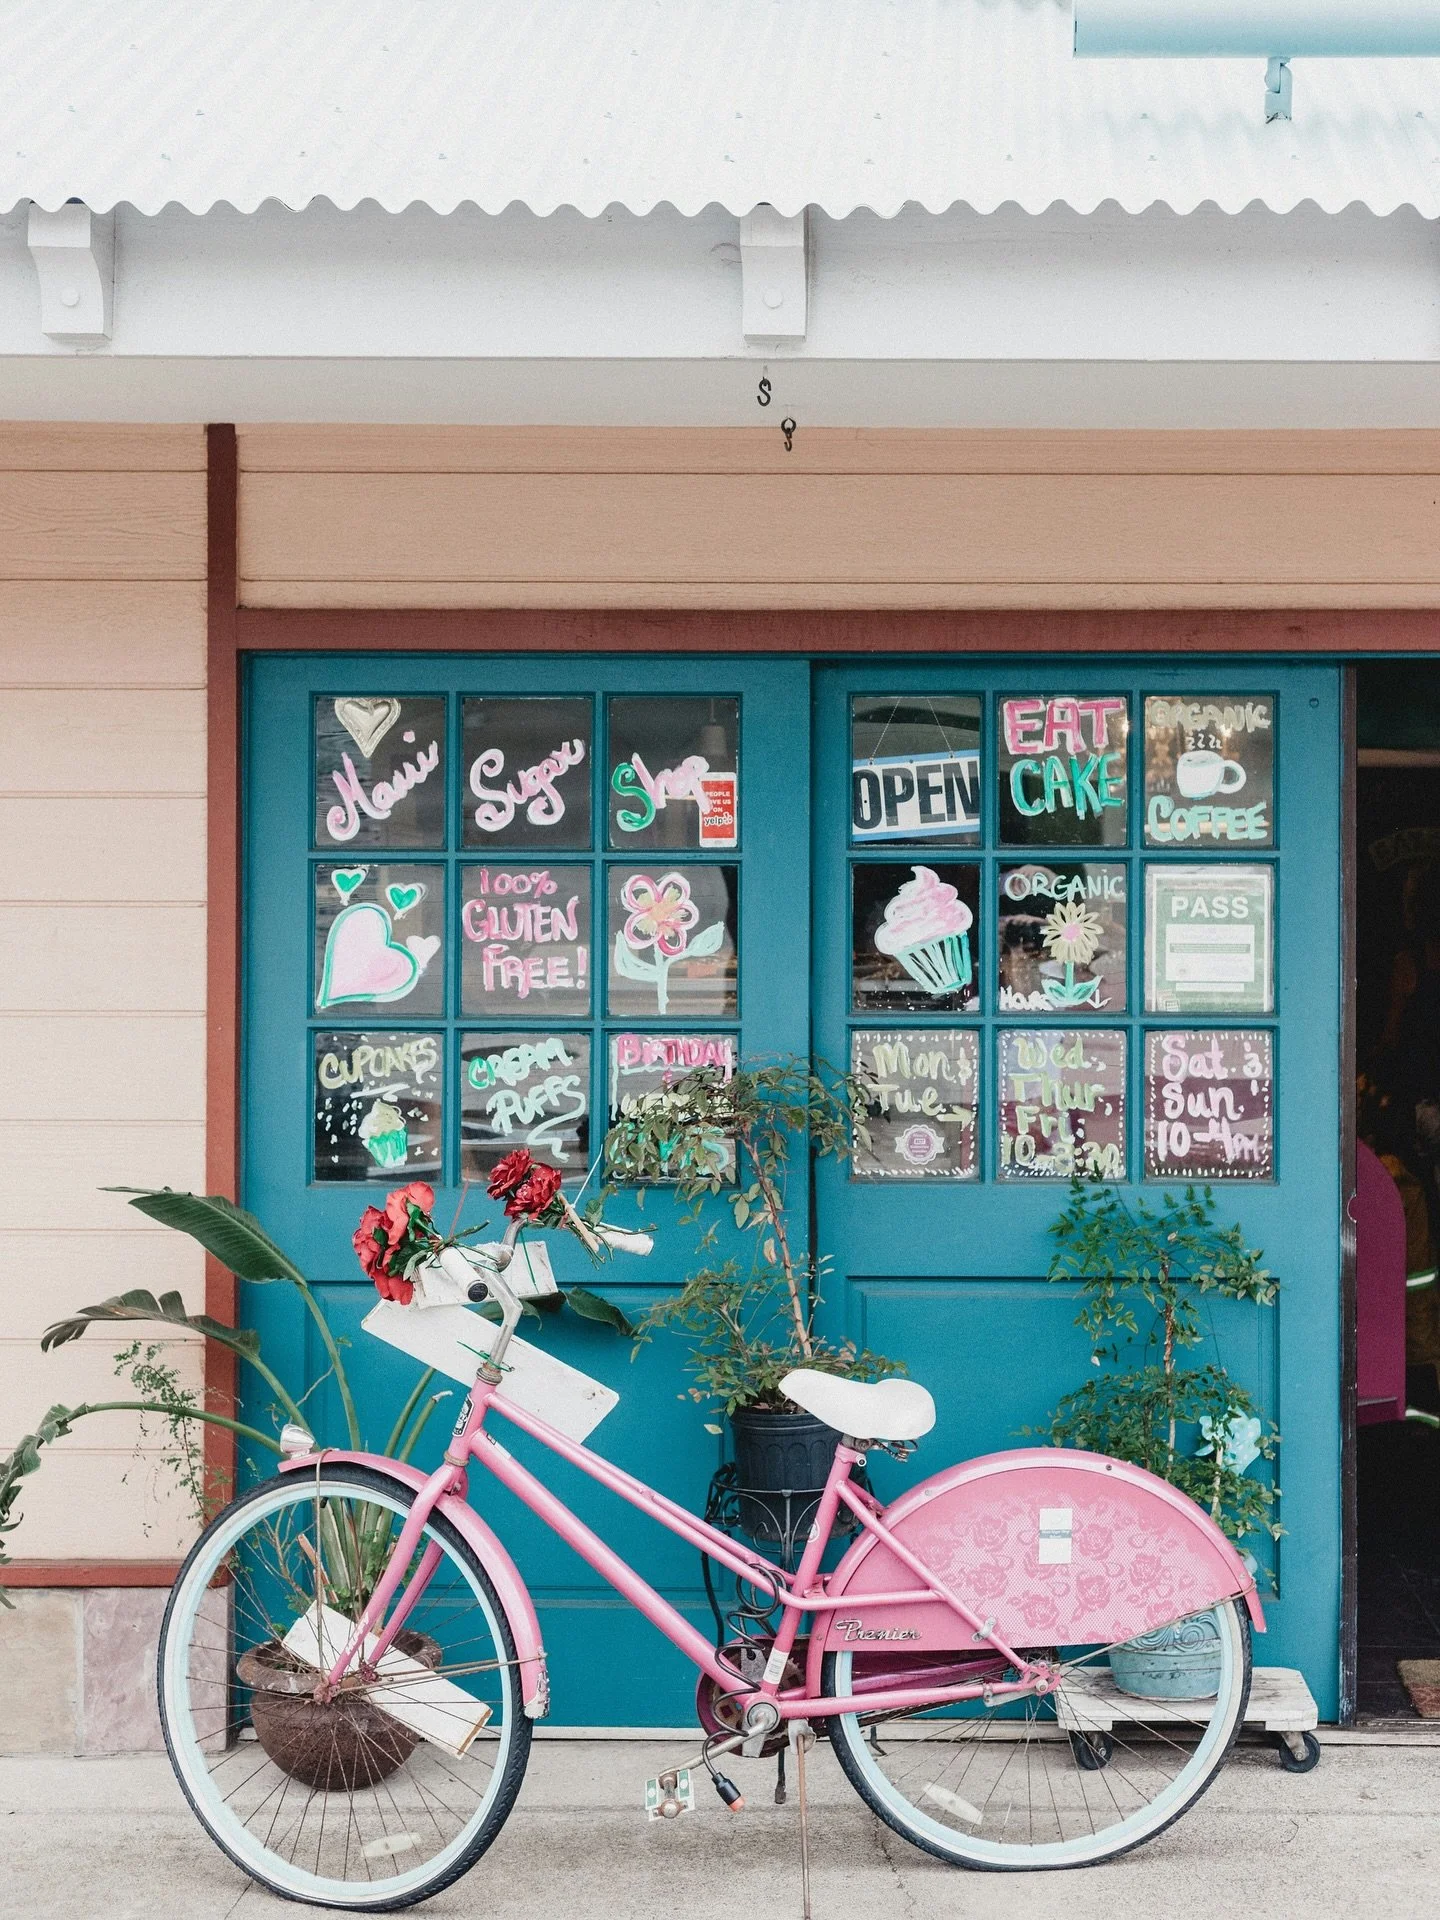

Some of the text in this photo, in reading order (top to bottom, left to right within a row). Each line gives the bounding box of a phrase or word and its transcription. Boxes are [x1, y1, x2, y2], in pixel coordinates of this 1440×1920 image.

[1003, 697, 1123, 755] EAT
[853, 760, 980, 830] OPEN
[1009, 752, 1125, 820] CAKE
[704, 815, 725, 827] yelp
[1148, 795, 1268, 842] COFFEE
[480, 868, 558, 898] 100%
[1005, 868, 1126, 902] ORGANIC
[462, 895, 580, 943] GLUTEN
[1171, 895, 1249, 919] PASS
[482, 943, 588, 999] FREE!
[835, 1618, 923, 1641] Premier
